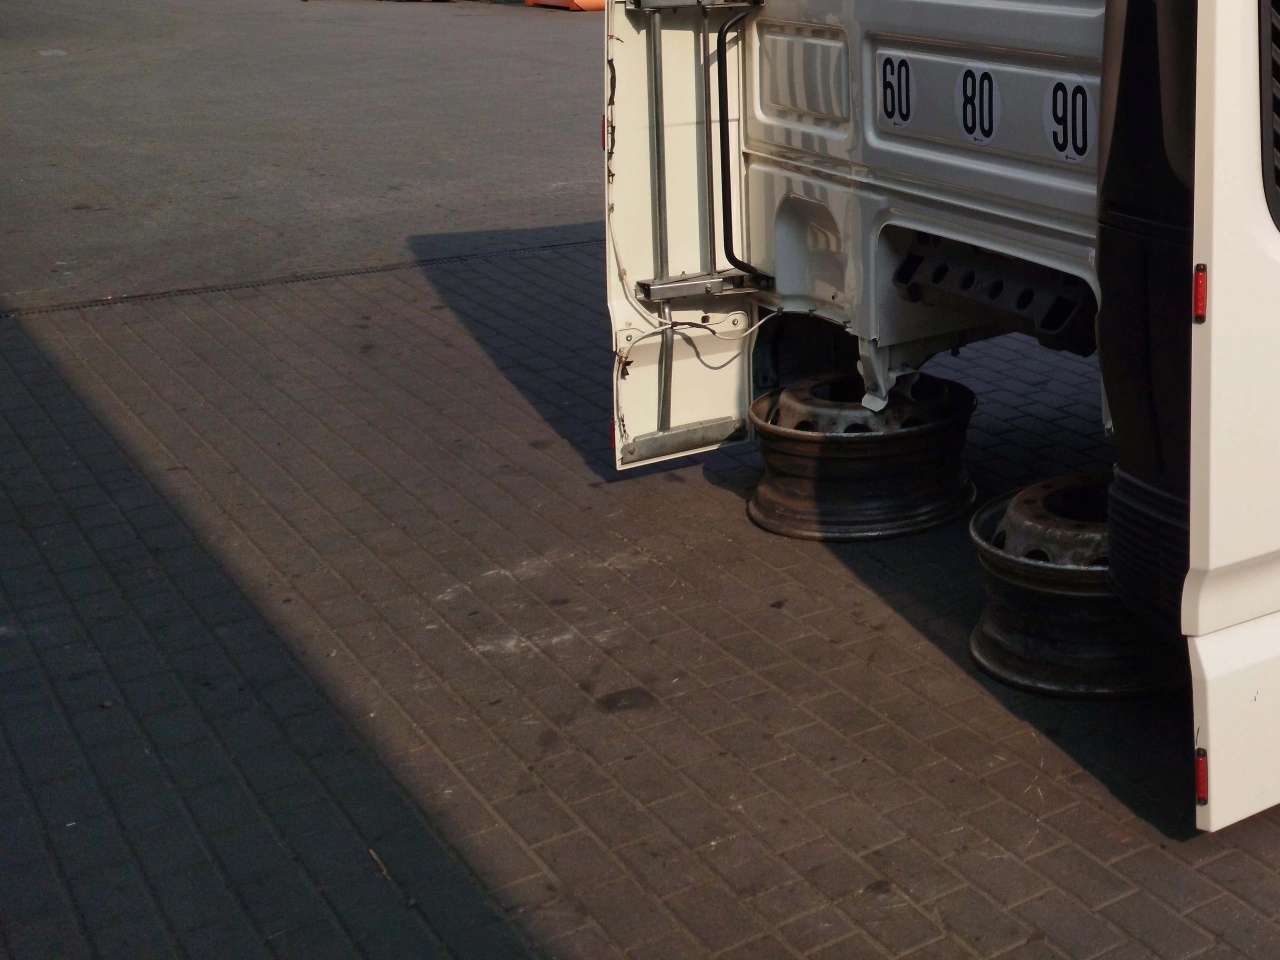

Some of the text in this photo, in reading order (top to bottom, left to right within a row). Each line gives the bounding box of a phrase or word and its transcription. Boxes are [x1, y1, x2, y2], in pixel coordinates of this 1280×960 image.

[882, 57, 911, 122] 60
[962, 69, 994, 139] 80
[1052, 81, 1088, 157] 90
